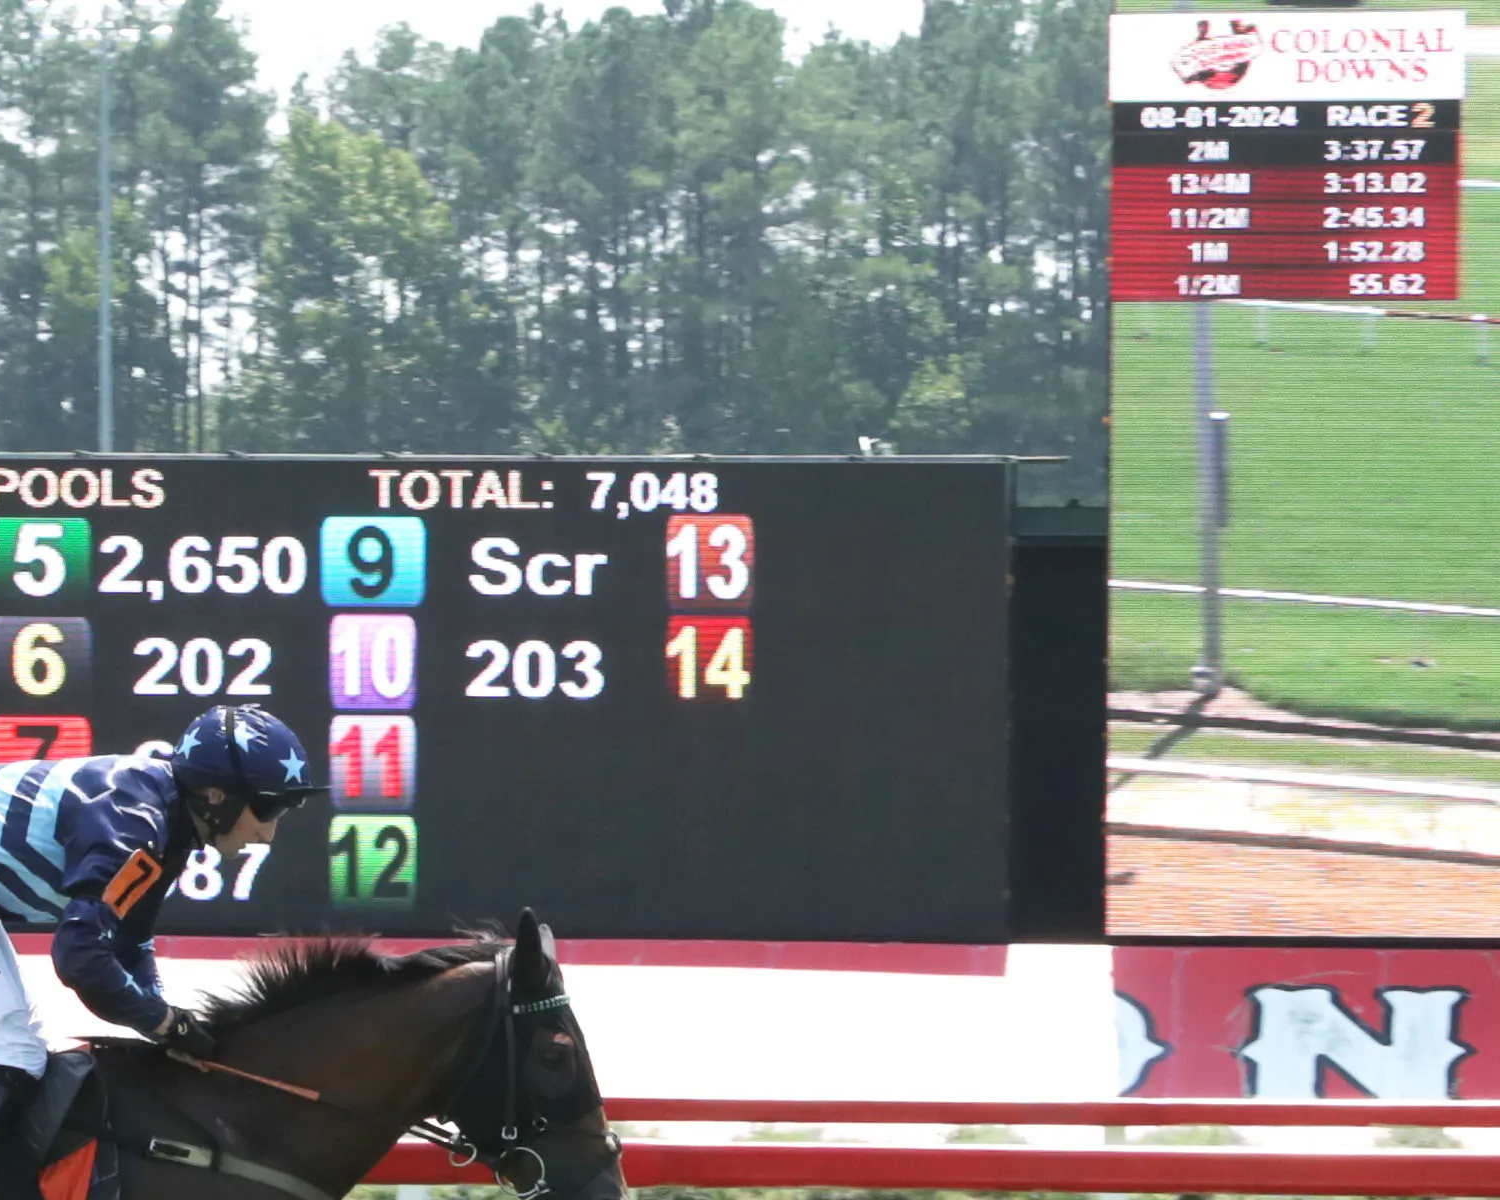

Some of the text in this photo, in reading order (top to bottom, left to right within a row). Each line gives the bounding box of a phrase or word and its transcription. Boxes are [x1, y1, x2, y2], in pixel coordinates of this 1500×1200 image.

[1271, 28, 1453, 54] COLONIAL
[1296, 59, 1429, 83] DOWNS
[1326, 105, 1409, 128] RACE
[1411, 103, 1436, 129] 2
[1187, 139, 1427, 162] 2M 3:37.57
[1322, 207, 1426, 229] 2:45.34
[1187, 242, 1230, 263] 1M
[1175, 273, 1426, 296] 1/2M 55.62
[368, 470, 719, 519] TOTAL: 7,048
[11, 523, 67, 598] 5
[97, 534, 307, 602] 2,650
[346, 525, 394, 598] 9
[468, 537, 608, 596] Scr
[665, 523, 749, 601] 13
[11, 623, 67, 697] 6
[132, 637, 273, 696] 202
[332, 625, 414, 699] 10
[464, 640, 605, 700] 203
[665, 625, 750, 700] 14
[331, 725, 402, 799] 11
[166, 843, 272, 901] 87
[331, 825, 412, 900] 12
[113, 857, 154, 908] 7
